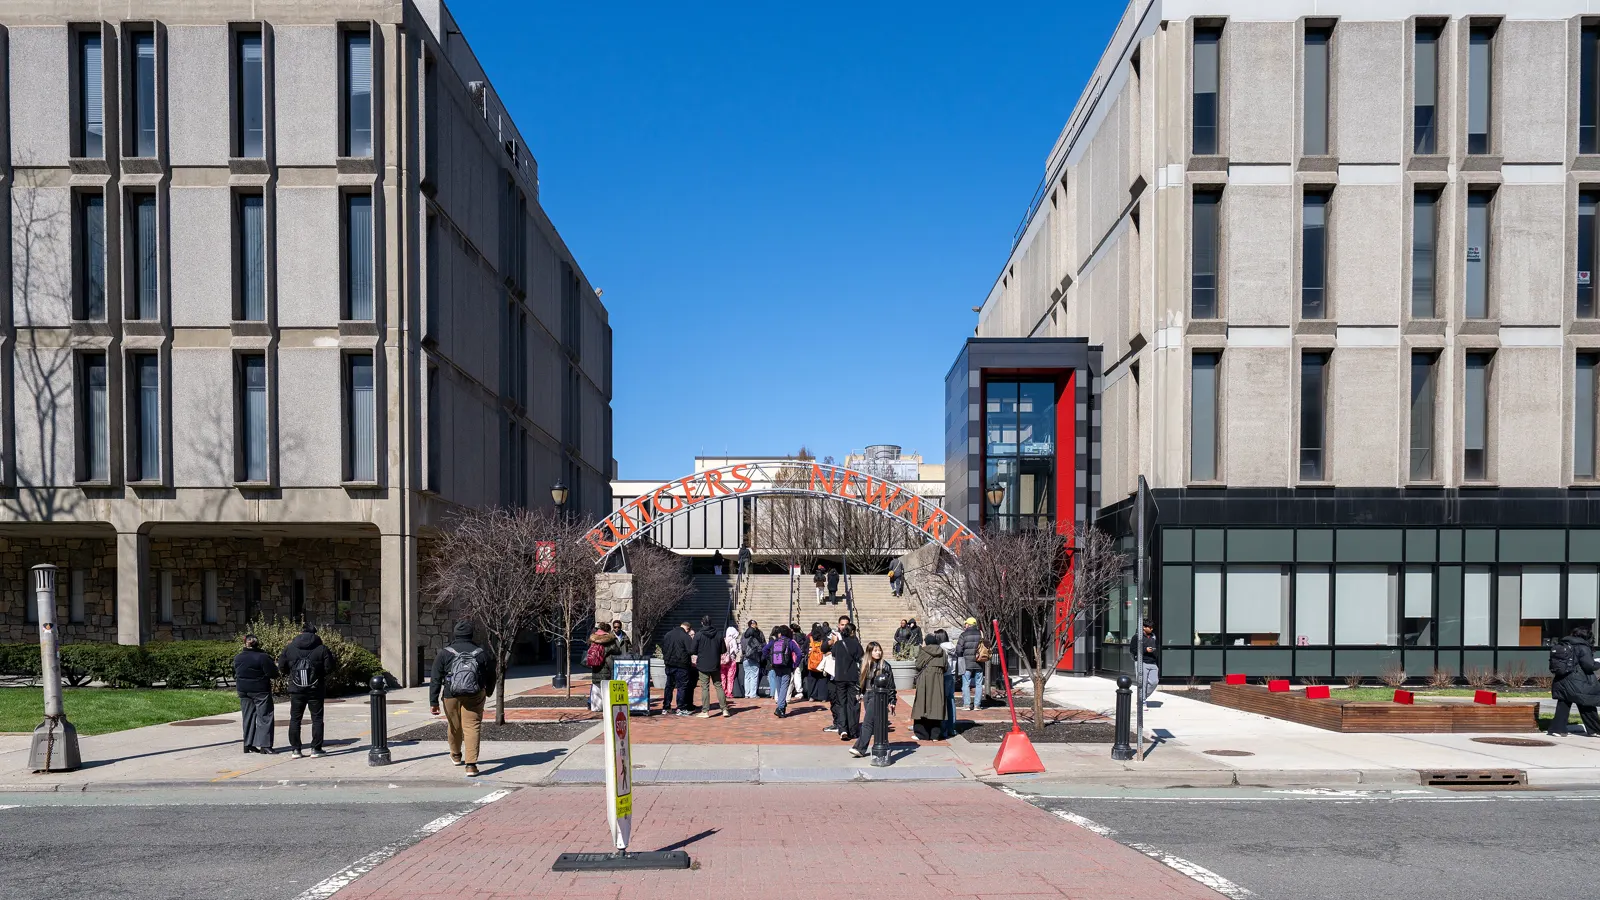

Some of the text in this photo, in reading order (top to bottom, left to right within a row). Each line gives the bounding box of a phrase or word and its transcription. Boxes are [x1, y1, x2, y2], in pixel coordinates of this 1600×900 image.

[585, 464, 974, 557] RUTGERS NEWARK
[1297, 635, 1310, 647] R
[612, 683, 625, 692] STATE
[615, 693, 625, 702] LAW
[616, 720, 627, 732] STOP
